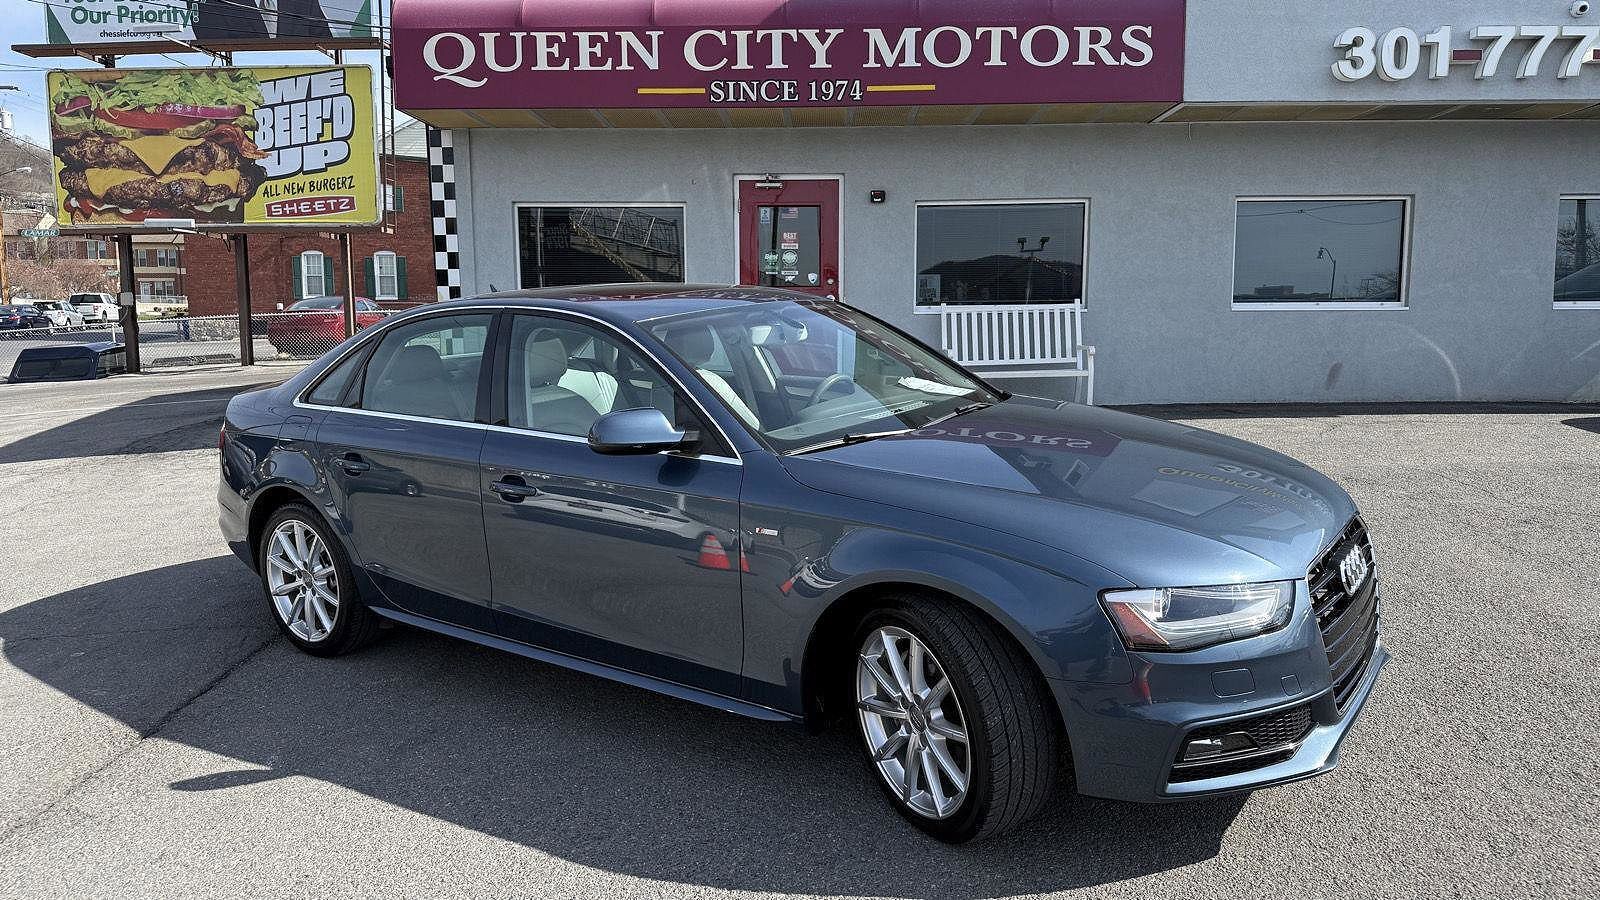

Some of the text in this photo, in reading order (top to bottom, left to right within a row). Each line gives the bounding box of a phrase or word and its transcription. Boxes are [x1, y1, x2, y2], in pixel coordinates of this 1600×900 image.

[70, 4, 199, 28] Our Priority!
[423, 25, 1154, 88] QUEEN CITY MOTORS
[1330, 26, 1600, 81] 301-777
[259, 69, 346, 104] WE
[709, 80, 863, 102] SINCE 1974
[253, 95, 354, 150] BEEF'D
[256, 140, 350, 178] UP
[262, 175, 356, 198] ALL NEW BURGERZ
[271, 198, 351, 216] SHEETZ
[24, 229, 56, 237] LAMAR
